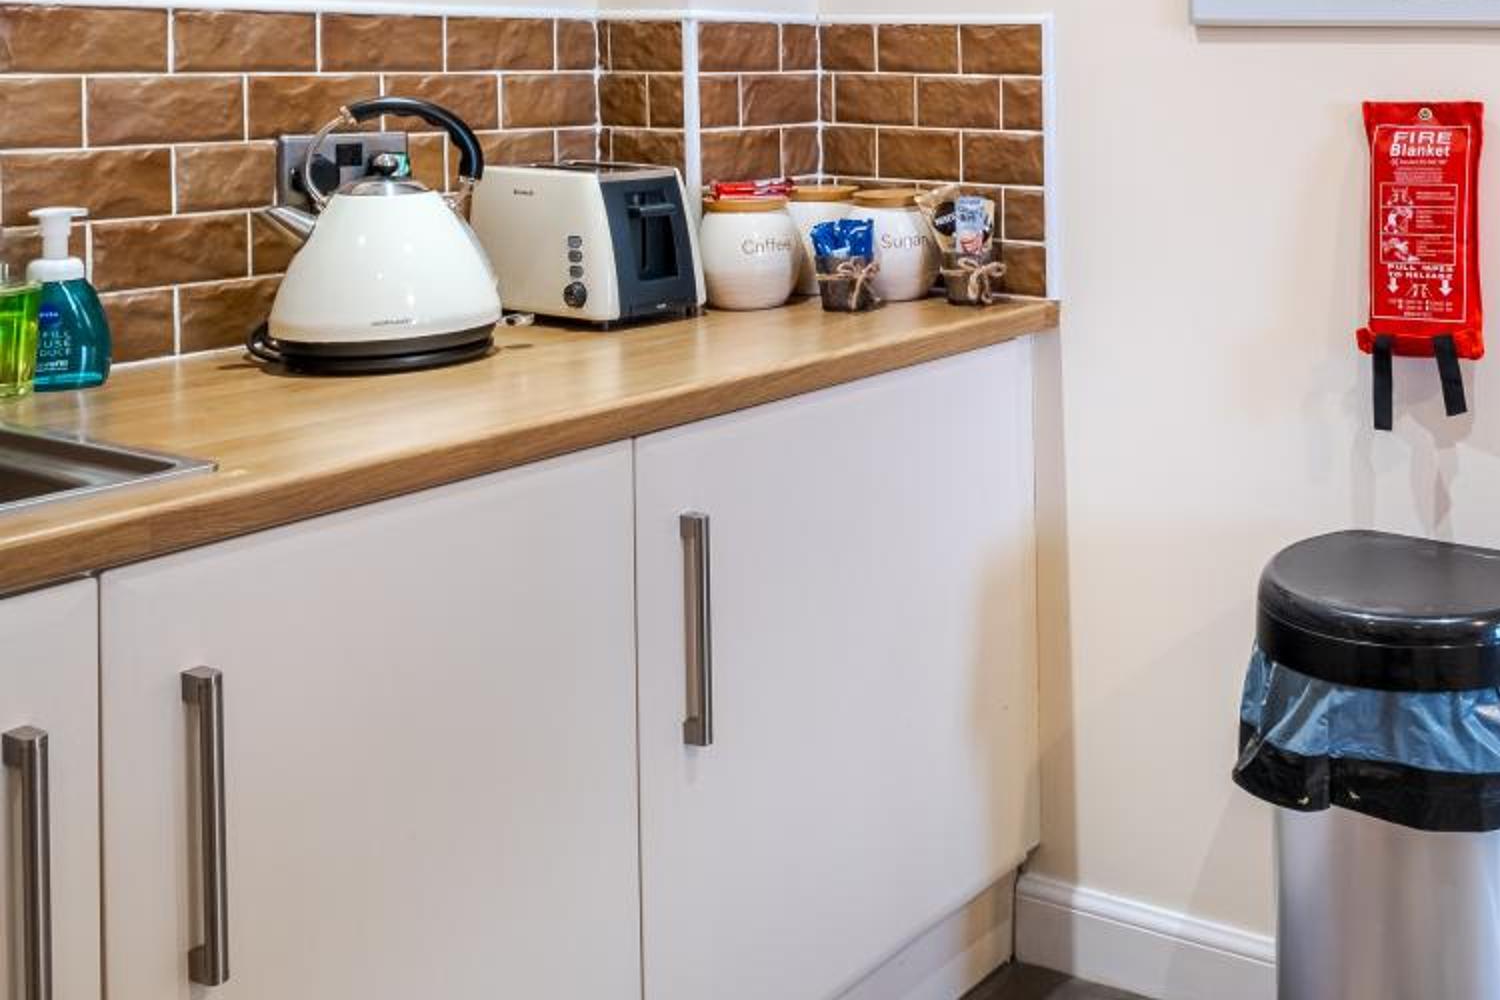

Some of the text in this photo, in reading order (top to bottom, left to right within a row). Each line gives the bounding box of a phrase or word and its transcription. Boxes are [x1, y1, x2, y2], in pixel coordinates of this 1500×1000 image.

[1393, 131, 1453, 144] FIRE
[1389, 143, 1451, 157] Blanket
[741, 238, 790, 255] Coffee
[880, 233, 927, 250] Sugar
